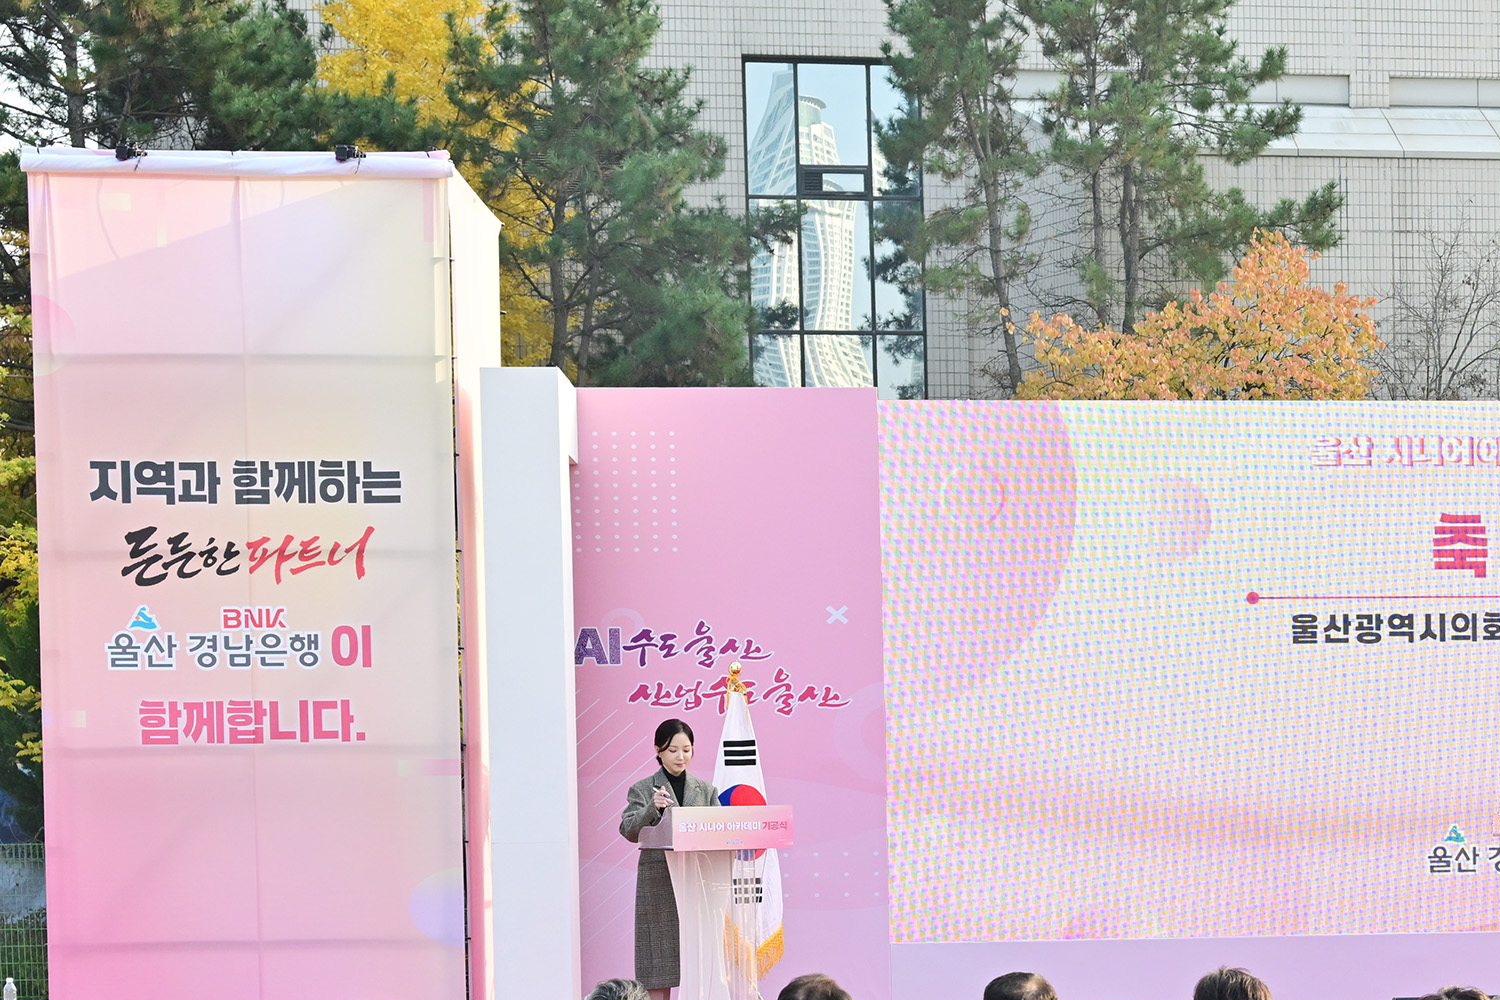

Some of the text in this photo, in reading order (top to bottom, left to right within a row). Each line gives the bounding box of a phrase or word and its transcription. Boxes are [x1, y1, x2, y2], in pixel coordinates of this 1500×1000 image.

[1309, 437, 1374, 467] 울산
[1382, 436, 1474, 467] 시니어
[89, 460, 402, 505] 지역과 함께하는
[121, 526, 375, 587] 든든한 파트너
[222, 609, 286, 628] BNK
[107, 625, 372, 669] 울산 경남은행 이
[139, 700, 366, 745] 함께합니다.
[699, 821, 726, 832] 시니어
[726, 821, 761, 831] 아카데미
[762, 821, 788, 831] 기공식
[1428, 846, 1480, 873] 울산
